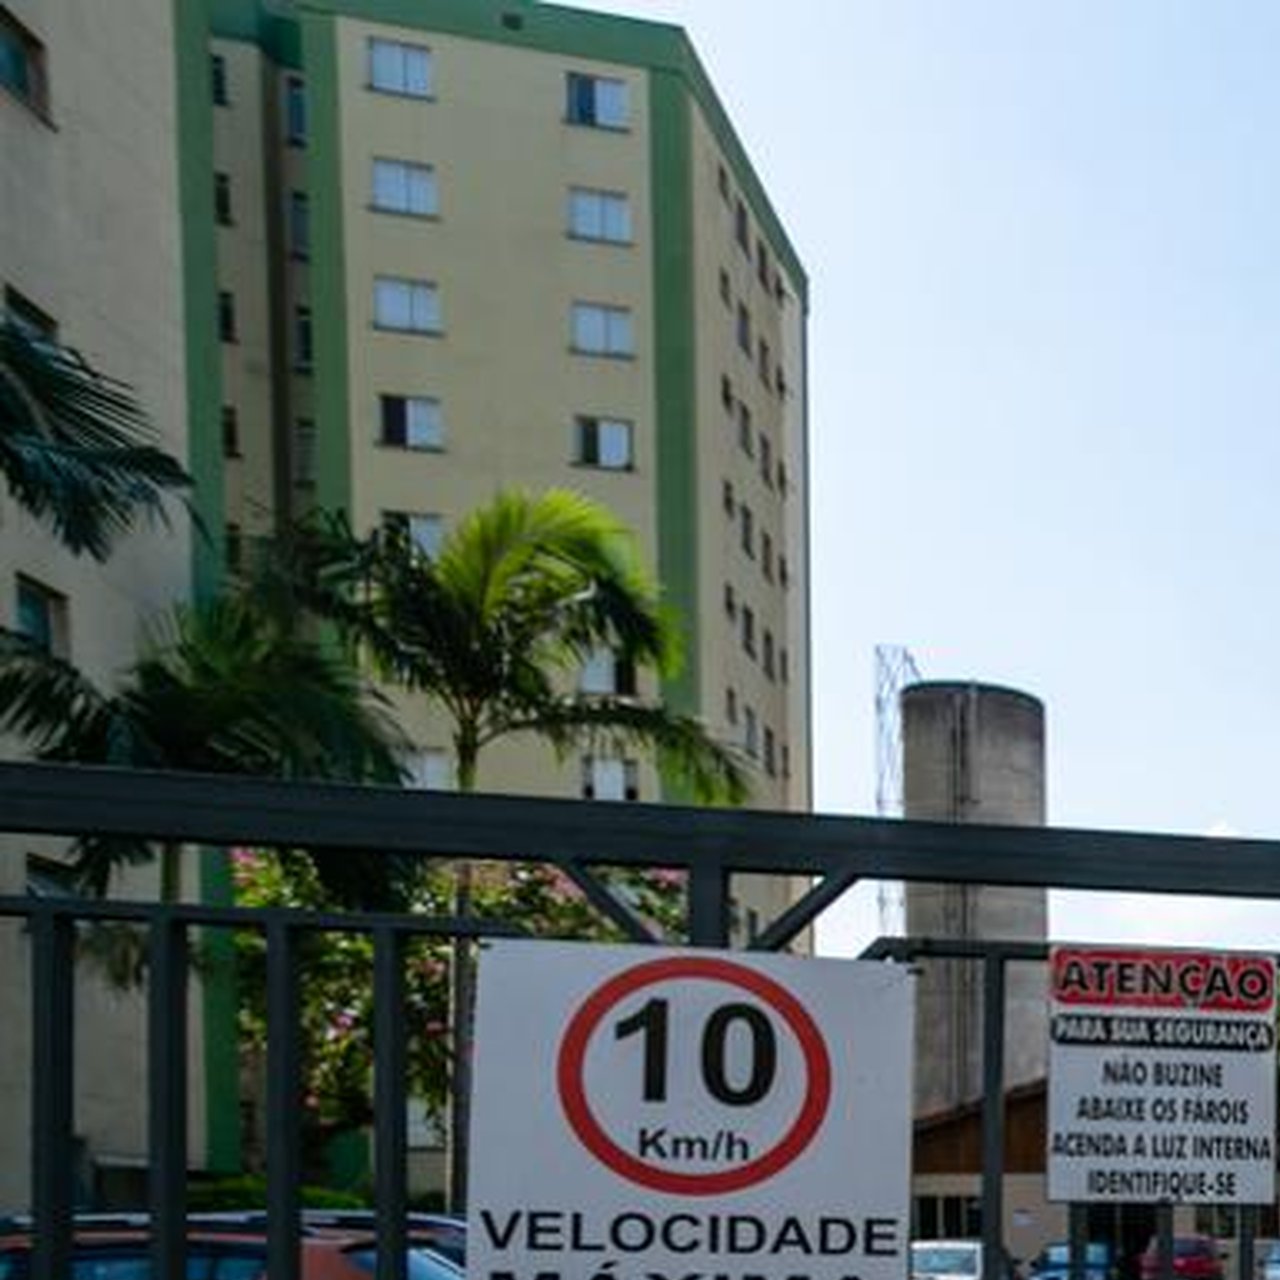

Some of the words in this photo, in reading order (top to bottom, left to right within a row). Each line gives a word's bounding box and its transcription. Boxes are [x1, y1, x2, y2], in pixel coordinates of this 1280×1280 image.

[1057, 1016, 1106, 1040] PARA
[1111, 1017, 1150, 1042] SUA
[1153, 1018, 1271, 1048] SEGURANÇA
[614, 998, 781, 1106] 10
[1103, 1056, 1148, 1085] NÃO
[1153, 1062, 1224, 1089] BUZINE
[1077, 1096, 1146, 1122] ABAIXE
[1152, 1097, 1178, 1123] OS
[637, 1126, 751, 1164] Km/h
[1053, 1133, 1128, 1159] ACENDA
[1133, 1134, 1148, 1159] A
[1152, 1134, 1188, 1160] LUZ
[1193, 1135, 1272, 1161] INTERNA
[1088, 1170, 1237, 1199] IDENTIFIQUE-SE
[481, 1211, 899, 1255] VELOCIDADE
